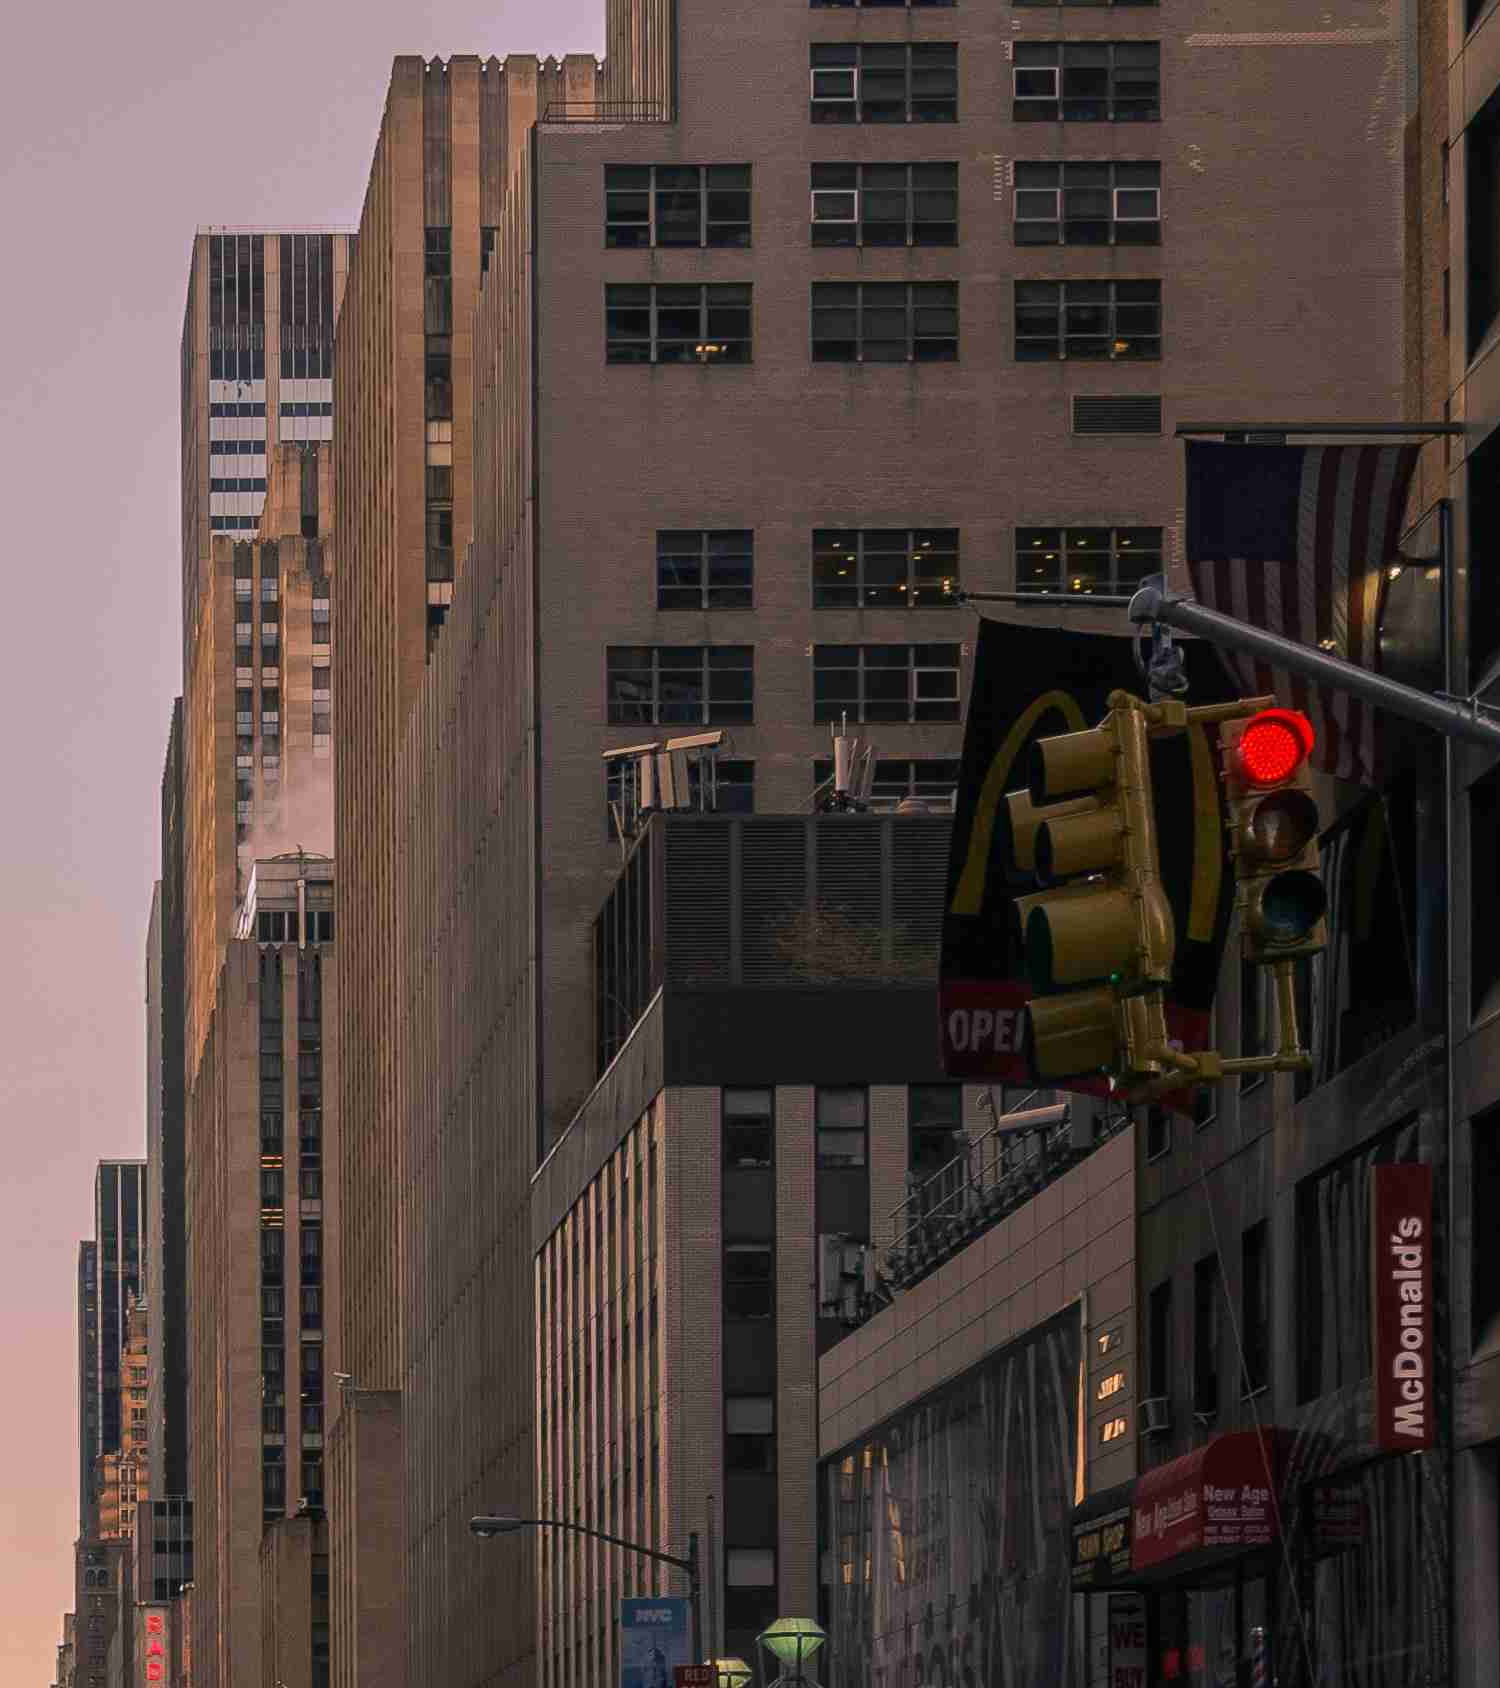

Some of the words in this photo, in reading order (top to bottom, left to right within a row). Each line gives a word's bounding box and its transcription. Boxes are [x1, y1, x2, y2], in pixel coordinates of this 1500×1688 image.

[1391, 1216, 1425, 1438] McDonald's
[1203, 1484, 1234, 1501] New
[1241, 1485, 1269, 1505] Age
